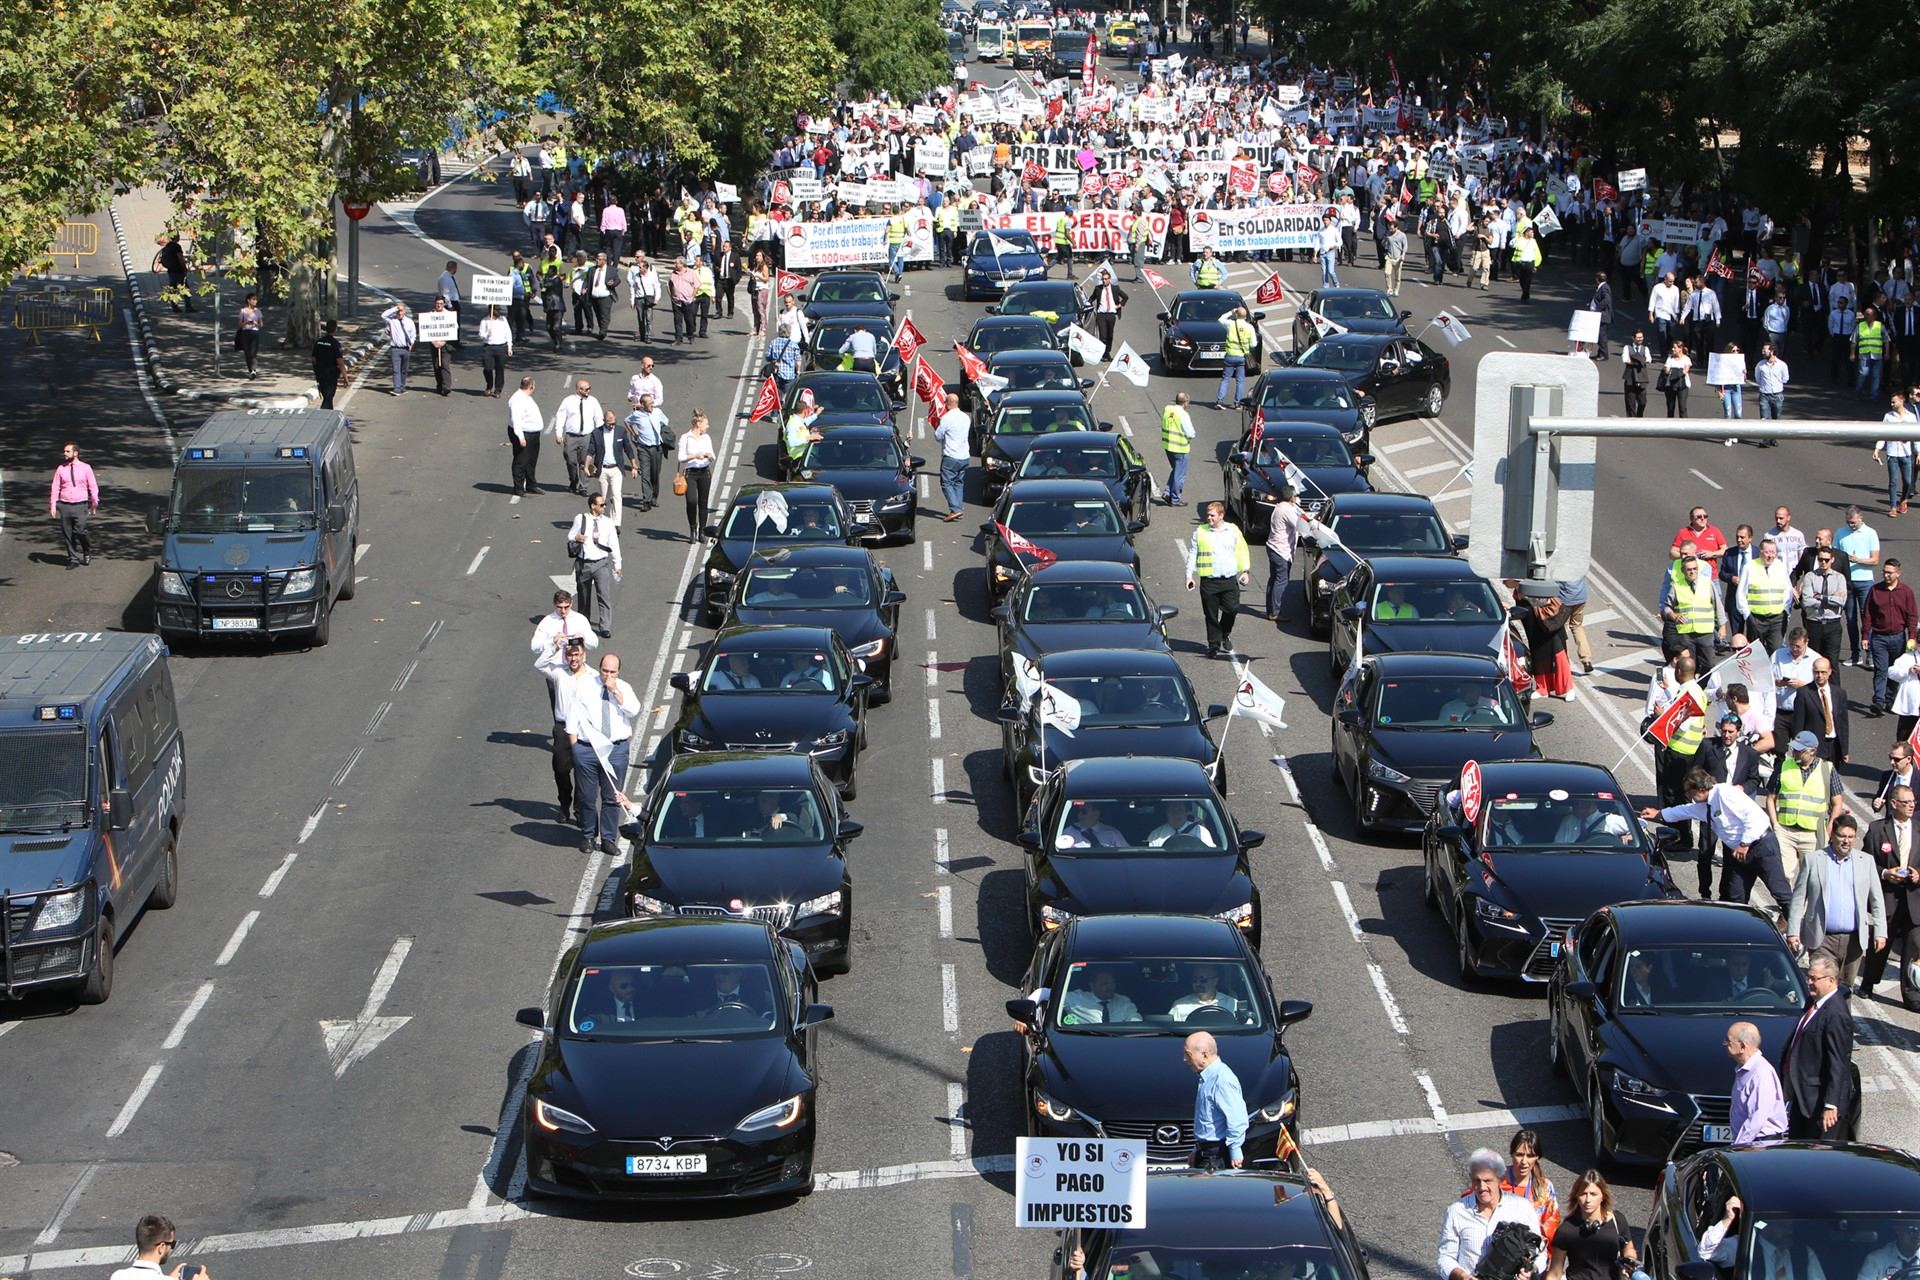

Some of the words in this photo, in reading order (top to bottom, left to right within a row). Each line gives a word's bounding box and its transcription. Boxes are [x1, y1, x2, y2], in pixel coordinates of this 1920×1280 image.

[1011, 147, 1048, 169] POR
[813, 225, 826, 236] Por
[827, 224, 834, 235] el
[835, 221, 886, 235] mantenimient
[1026, 216, 1051, 232] EL
[1218, 222, 1234, 236] En
[1238, 217, 1321, 235] SOLIDARIDAD
[810, 238, 840, 251] puestos
[840, 237, 851, 248] de
[851, 235, 878, 250] trabajo
[1218, 239, 1233, 247] con
[1234, 236, 1246, 246] los
[1248, 234, 1295, 248] trabajadores
[1297, 233, 1307, 243] de
[811, 252, 839, 265] 15.000
[861, 253, 868, 261] SE
[1057, 1142, 1080, 1162] YO
[1085, 1143, 1104, 1162] SI
[637, 1158, 671, 1171] 8734
[676, 1158, 702, 1170] KBP
[1056, 1173, 1105, 1193] PAGO
[1027, 1203, 1133, 1223] IMPUESTOS
